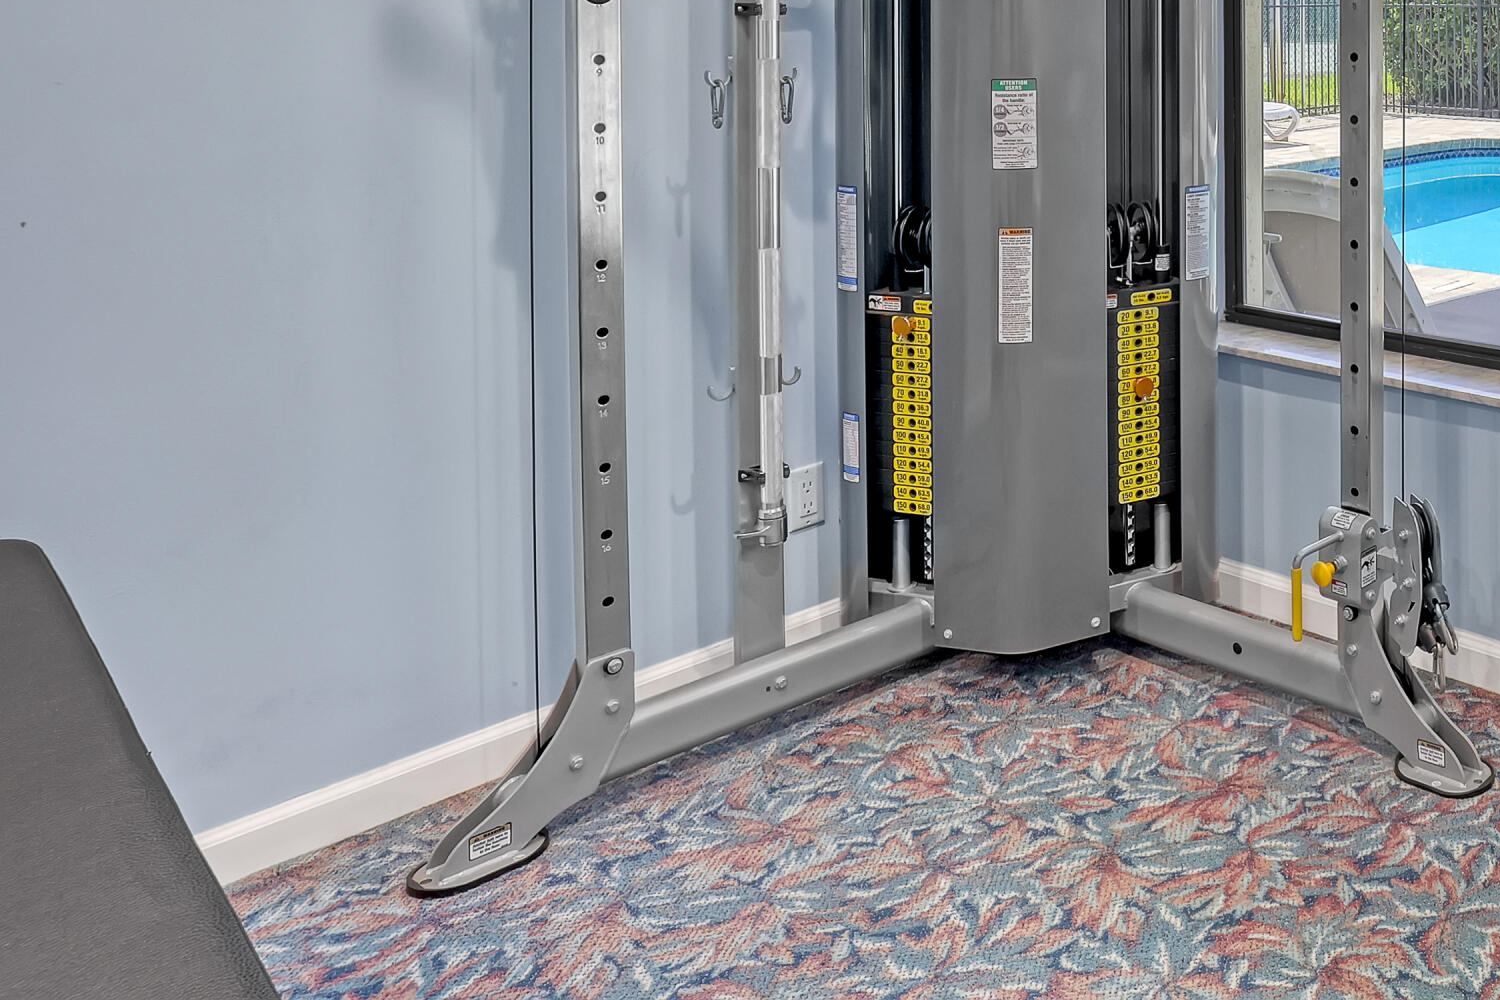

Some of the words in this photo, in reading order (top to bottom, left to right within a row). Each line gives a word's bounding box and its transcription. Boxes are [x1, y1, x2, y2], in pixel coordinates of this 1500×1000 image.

[596, 136, 605, 145] 10
[595, 204, 606, 214] 11
[1121, 312, 1129, 320] 20
[1122, 450, 1133, 458] 120
[600, 476, 611, 485] 15
[1122, 478, 1133, 486] 140
